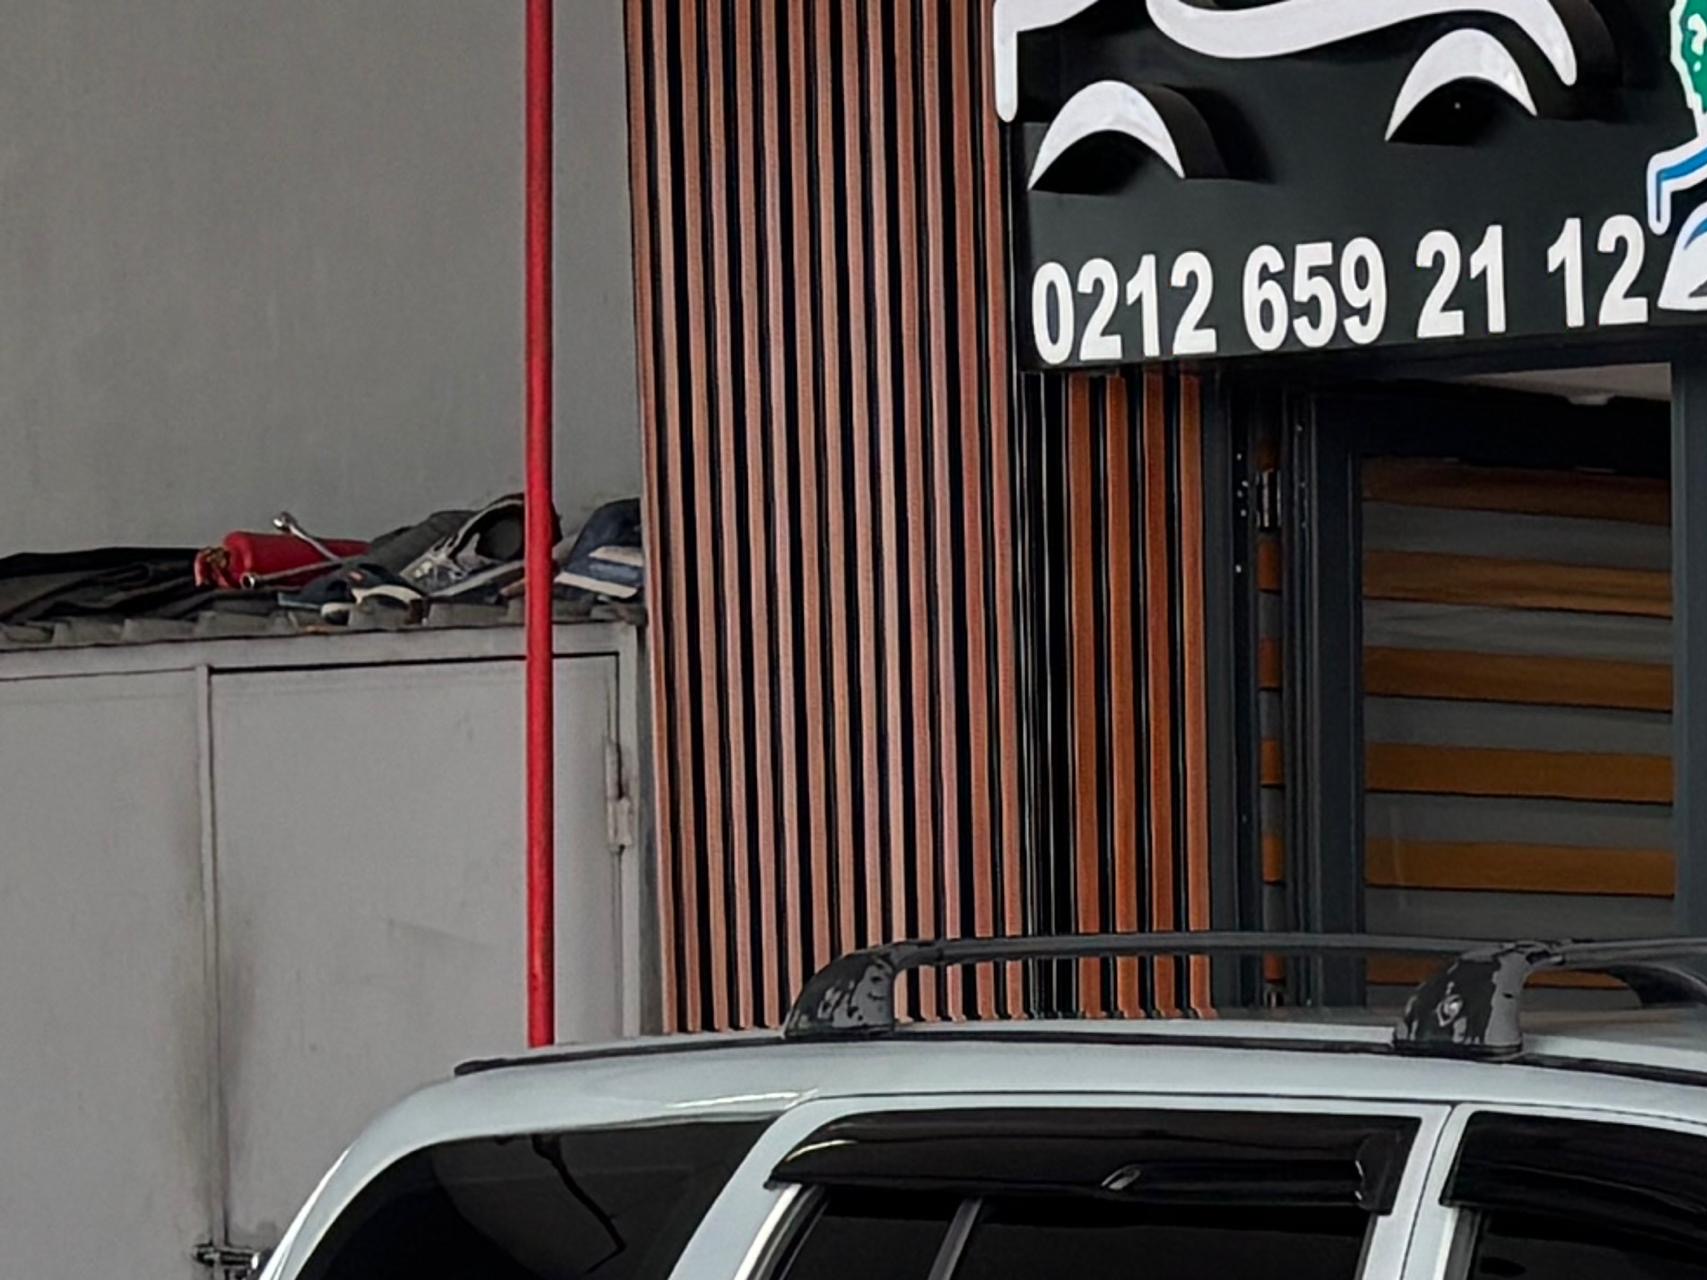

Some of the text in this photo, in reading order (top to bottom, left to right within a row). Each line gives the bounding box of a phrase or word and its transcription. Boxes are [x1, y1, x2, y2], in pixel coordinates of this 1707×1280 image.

[1031, 215, 1649, 364] 0212 659 21 12
